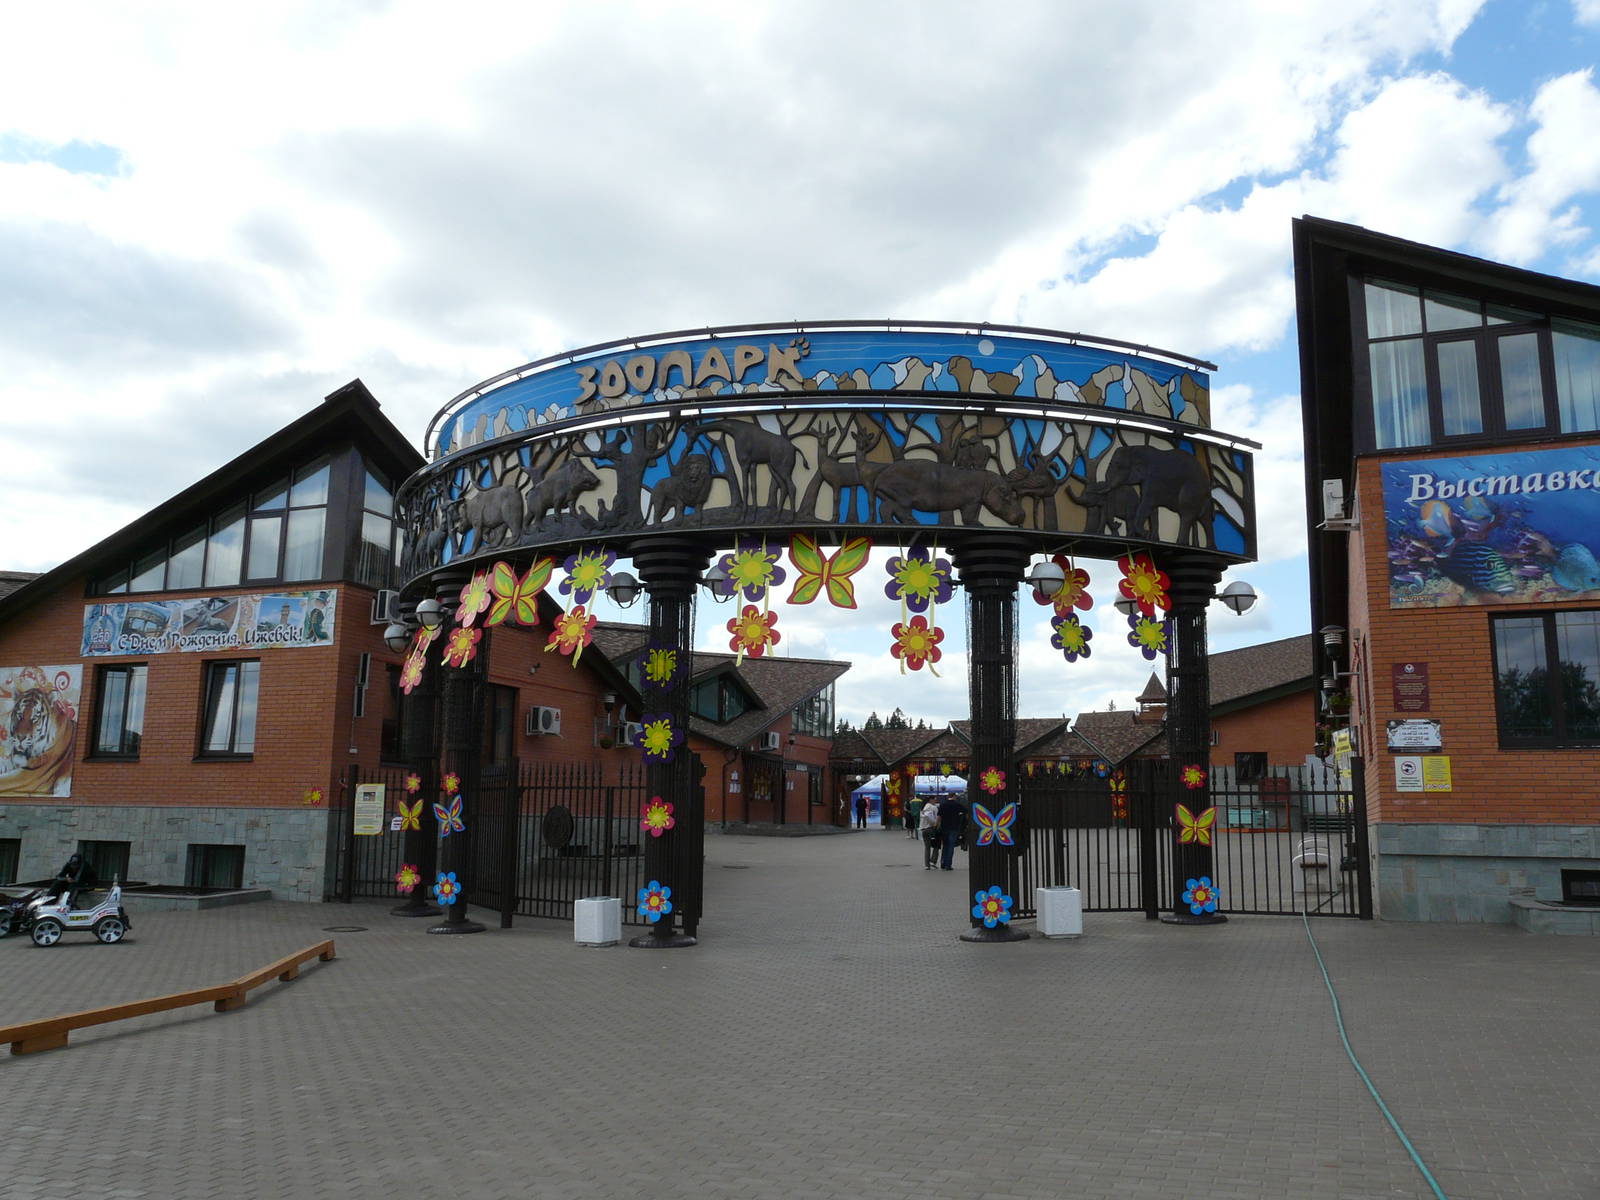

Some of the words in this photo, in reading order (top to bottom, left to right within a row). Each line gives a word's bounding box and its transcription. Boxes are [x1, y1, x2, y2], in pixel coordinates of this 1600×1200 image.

[575, 342, 804, 405] ЗООПАРК
[92, 632, 111, 642] 250
[118, 636, 128, 650] С
[130, 634, 168, 651] Днем
[245, 624, 303, 643] Ижевск!
